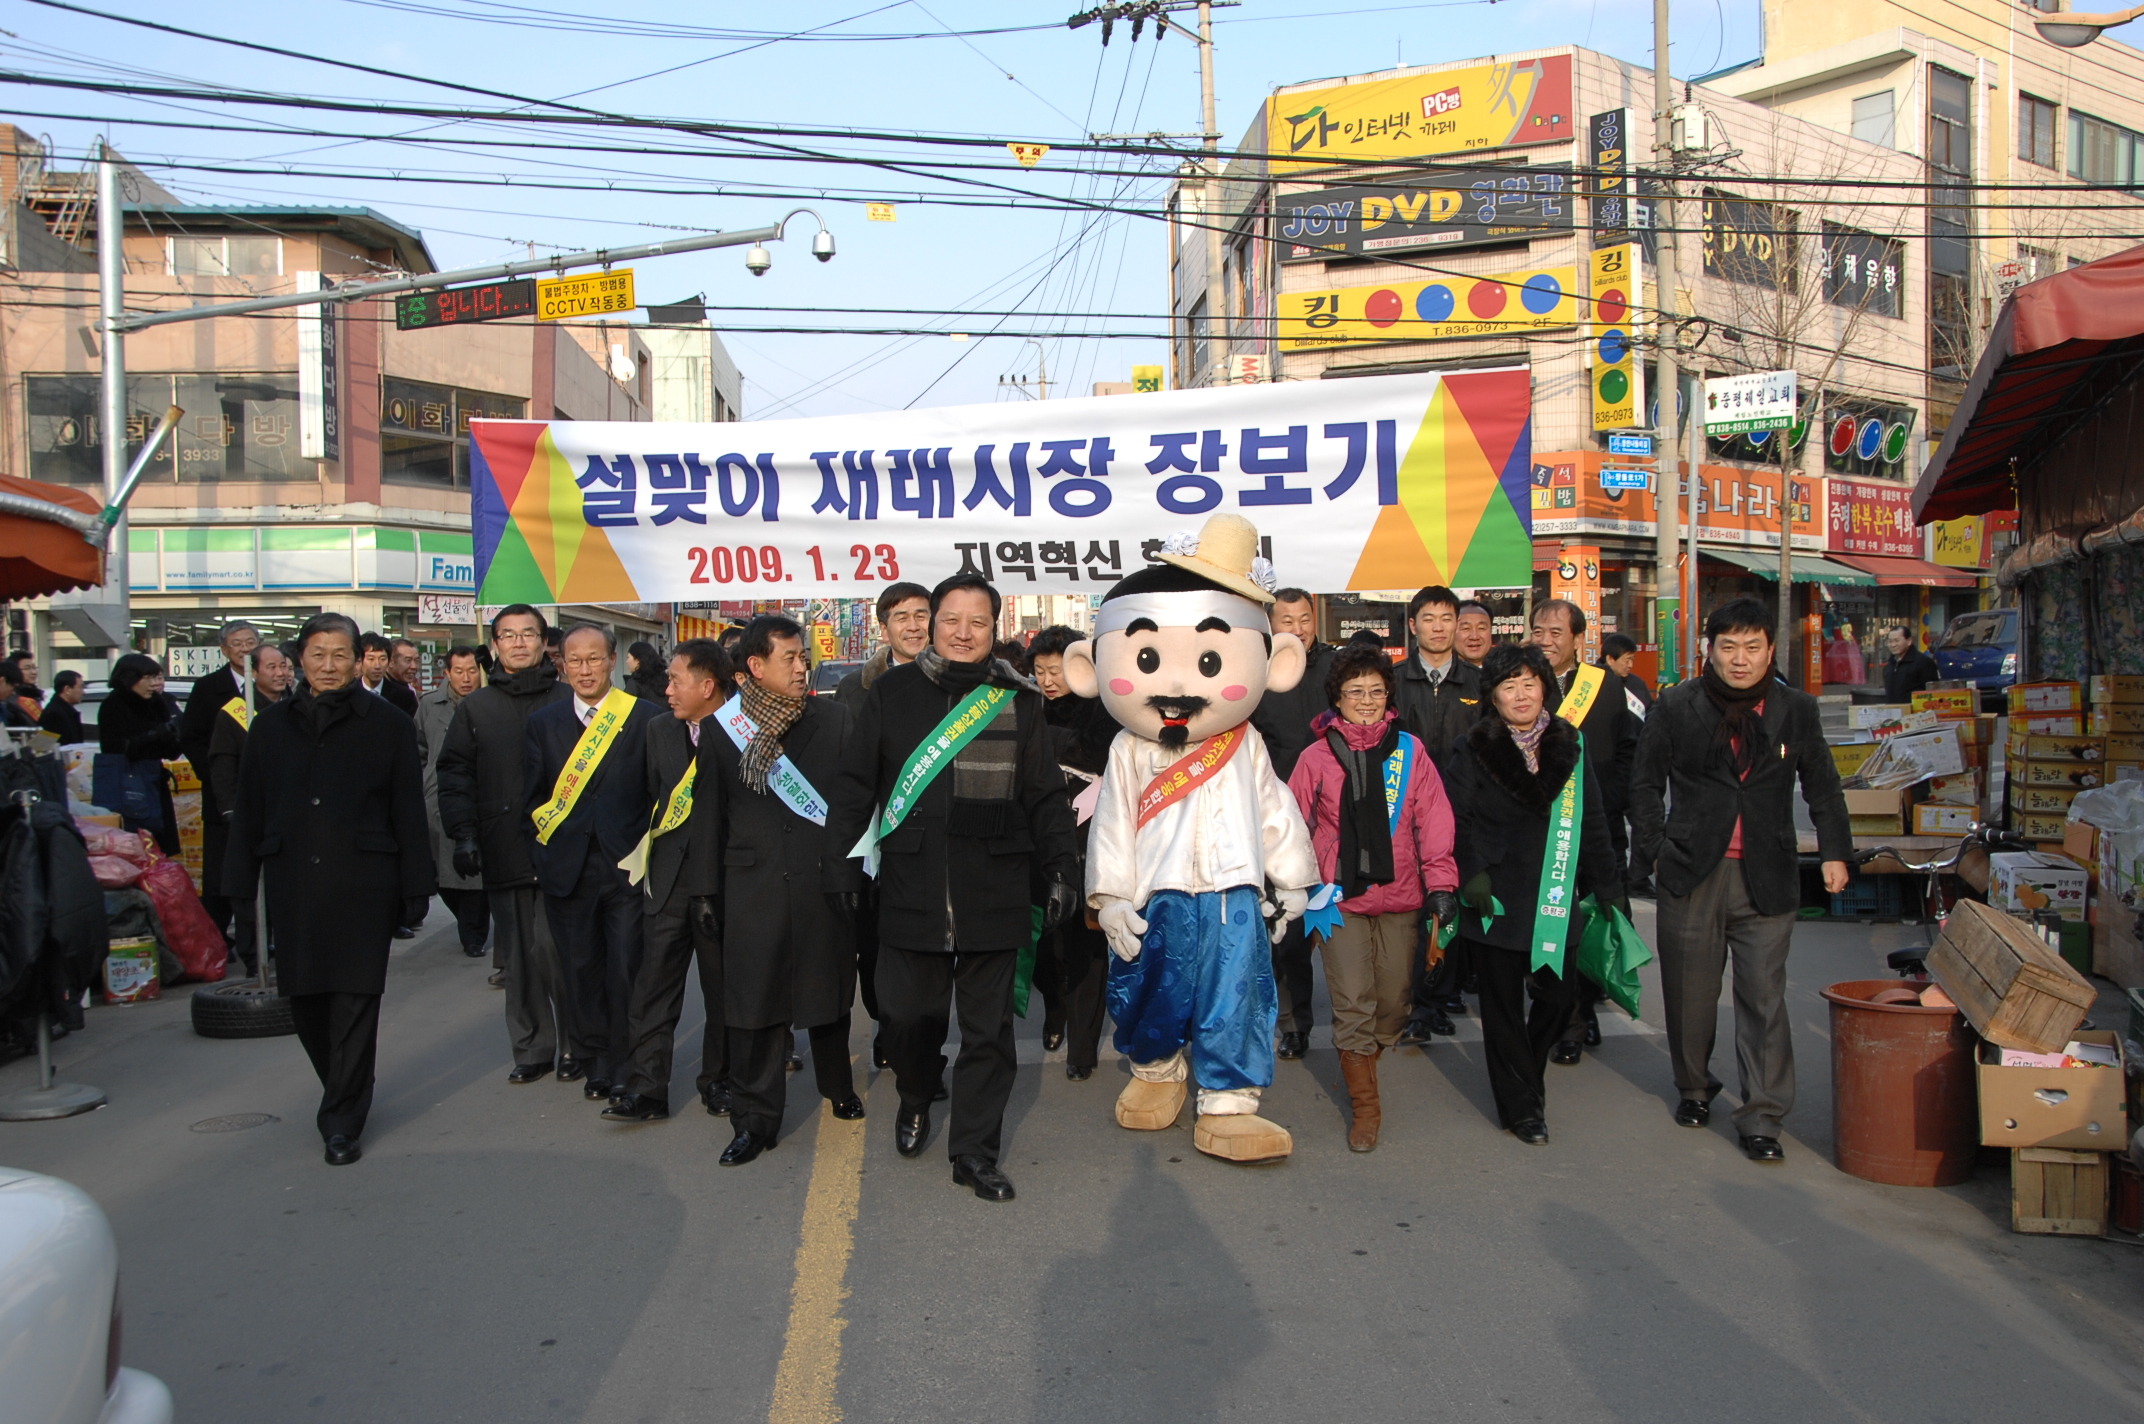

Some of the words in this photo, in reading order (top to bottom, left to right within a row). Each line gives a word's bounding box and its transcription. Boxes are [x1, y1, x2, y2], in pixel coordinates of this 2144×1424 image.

[1422, 91, 1461, 119] PC방
[1284, 104, 1339, 153] 다
[1344, 111, 1412, 144] 인터넷
[1419, 120, 1457, 137] 까페
[1598, 112, 1619, 150] JOY
[1282, 200, 1355, 239] JOY
[1360, 189, 1464, 232] DVD
[1470, 173, 1564, 224] 영화관
[1703, 202, 1715, 267] JOY
[1723, 225, 1773, 261] DVD
[1600, 250, 1623, 273] 킹
[544, 285, 591, 299] 불법주정차
[599, 279, 627, 291] 방범용
[546, 298, 587, 316] CCTV
[590, 294, 628, 311] 작동중
[1303, 294, 1339, 329] 킹
[1432, 322, 1509, 337] T.836-0973
[1720, 385, 1791, 409] 증평제일교회
[1595, 408, 1634, 424] 836-0973
[575, 451, 780, 528] 설맞이
[808, 436, 1116, 521] 재래시장
[1143, 419, 1399, 516] 장보기
[1709, 529, 1740, 540] 836-4940
[165, 569, 254, 580] www.familymart.co.kr
[687, 545, 793, 584] 2009.
[805, 544, 838, 582] 1.
[849, 543, 901, 582] 23
[954, 540, 1123, 583] 지역혁신
[442, 600, 469, 615] 선물이
[1584, 589, 1599, 665] 김밥나라
[573, 710, 618, 774] 재래시장을
[1187, 730, 1235, 778] 재래시장을
[901, 745, 942, 797] 애용합시다
[2032, 766, 2062, 782] 늘해랑
[536, 772, 580, 832] 애용합시다
[2030, 793, 2061, 809] 늘해랑
[2029, 820, 2060, 835] 늘해랑
[1550, 829, 1572, 882] 애용합시다
[1541, 905, 1566, 917] 증평군
